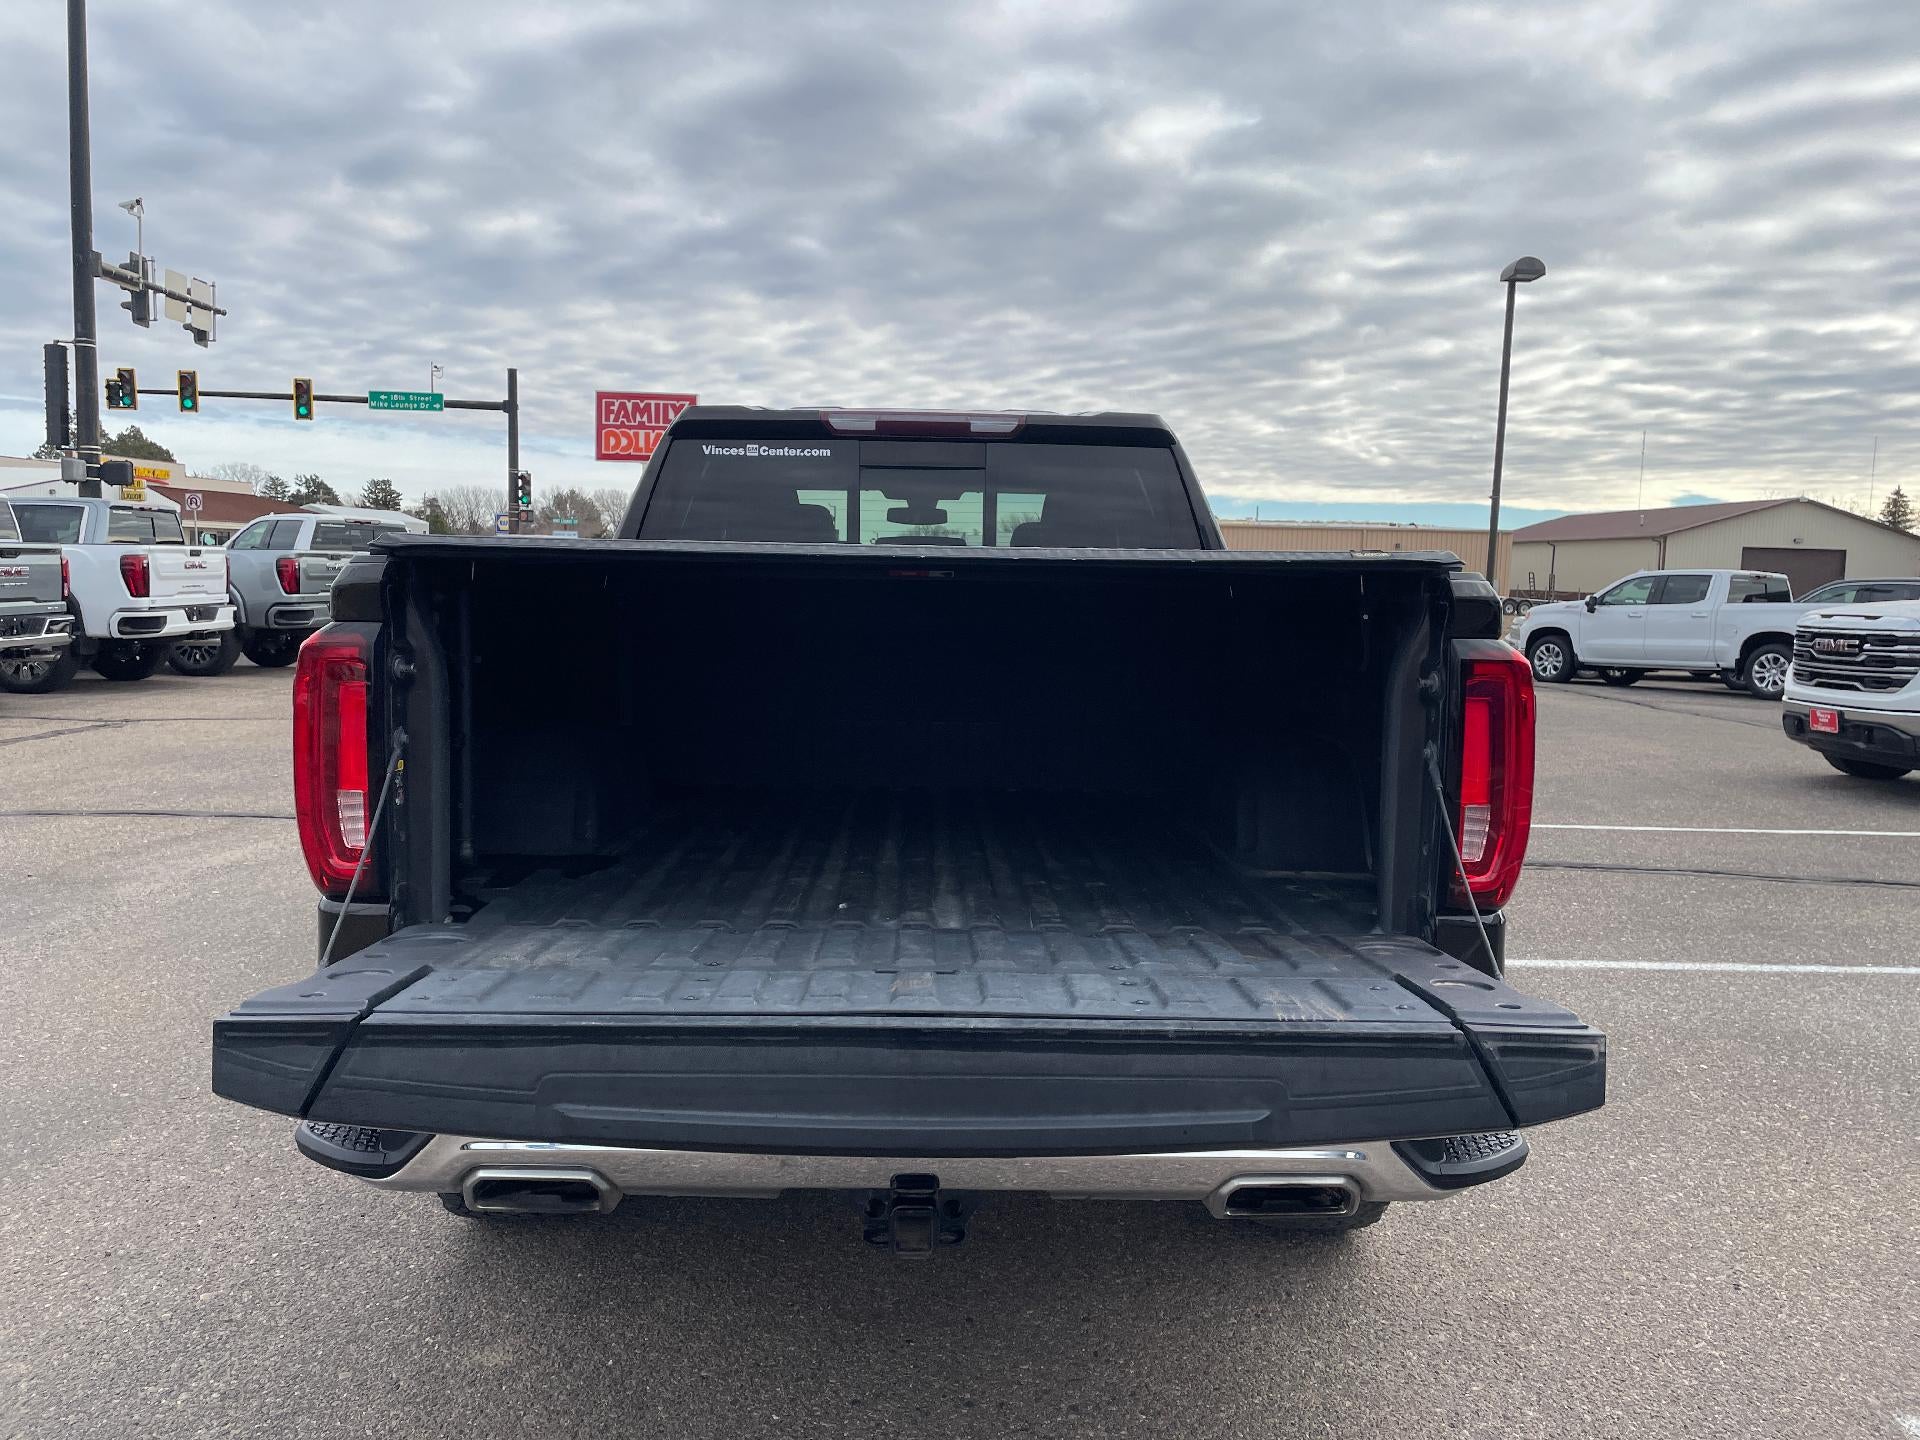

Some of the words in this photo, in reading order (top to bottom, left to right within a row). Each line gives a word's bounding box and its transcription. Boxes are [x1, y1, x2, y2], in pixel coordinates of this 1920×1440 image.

[390, 402, 417, 410] Lounge
[602, 399, 688, 426] FAMILY
[184, 561, 207, 569] GMC
[1814, 638, 1859, 652] GMC
